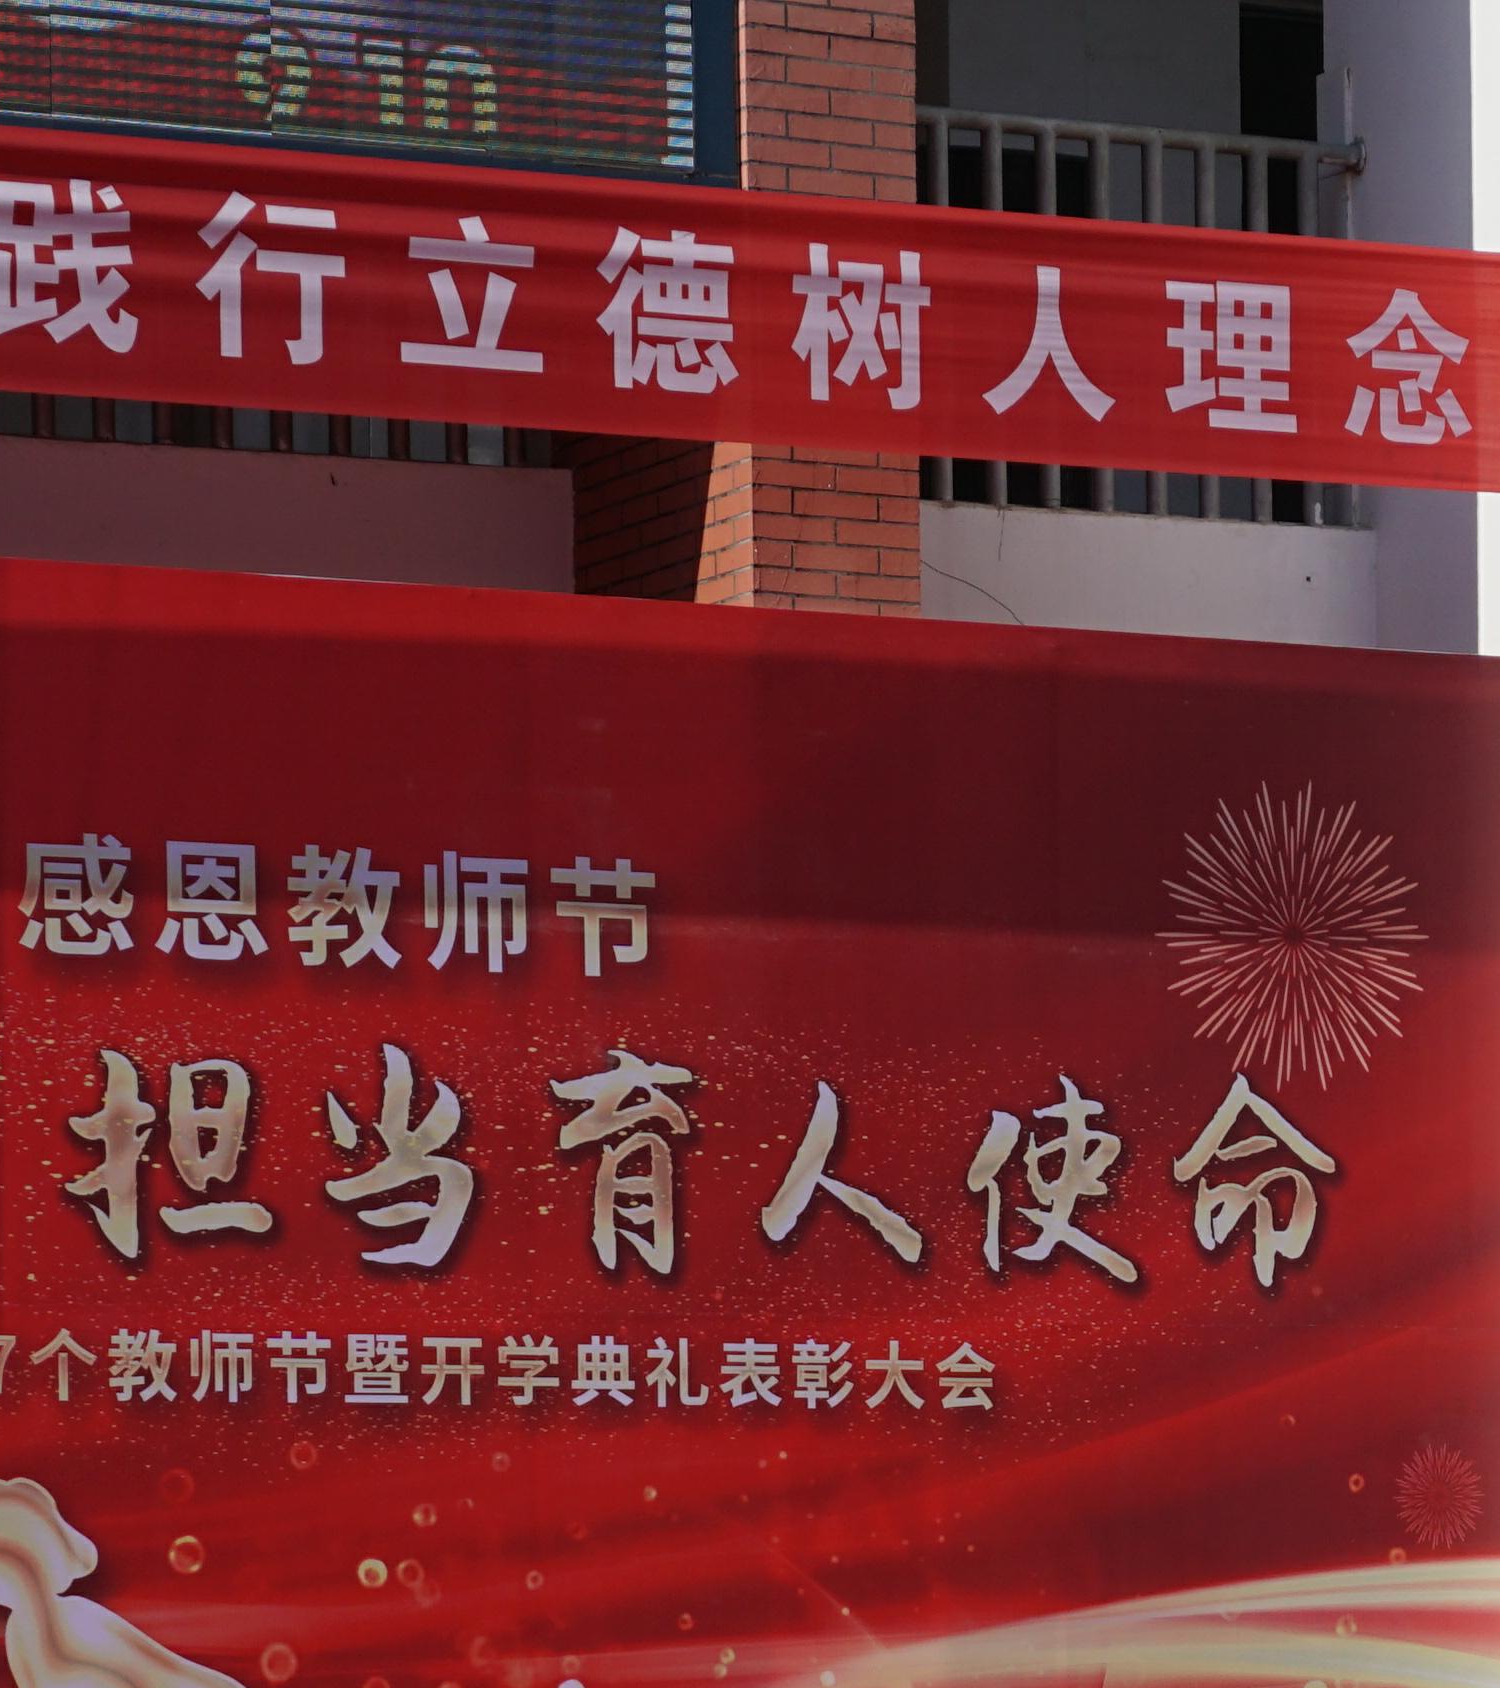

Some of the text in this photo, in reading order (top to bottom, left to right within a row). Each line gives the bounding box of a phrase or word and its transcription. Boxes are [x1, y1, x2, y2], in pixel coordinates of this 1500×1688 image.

[18, 834, 658, 979] 感恩教师节
[64, 1042, 1338, 1289] 担当育人使命
